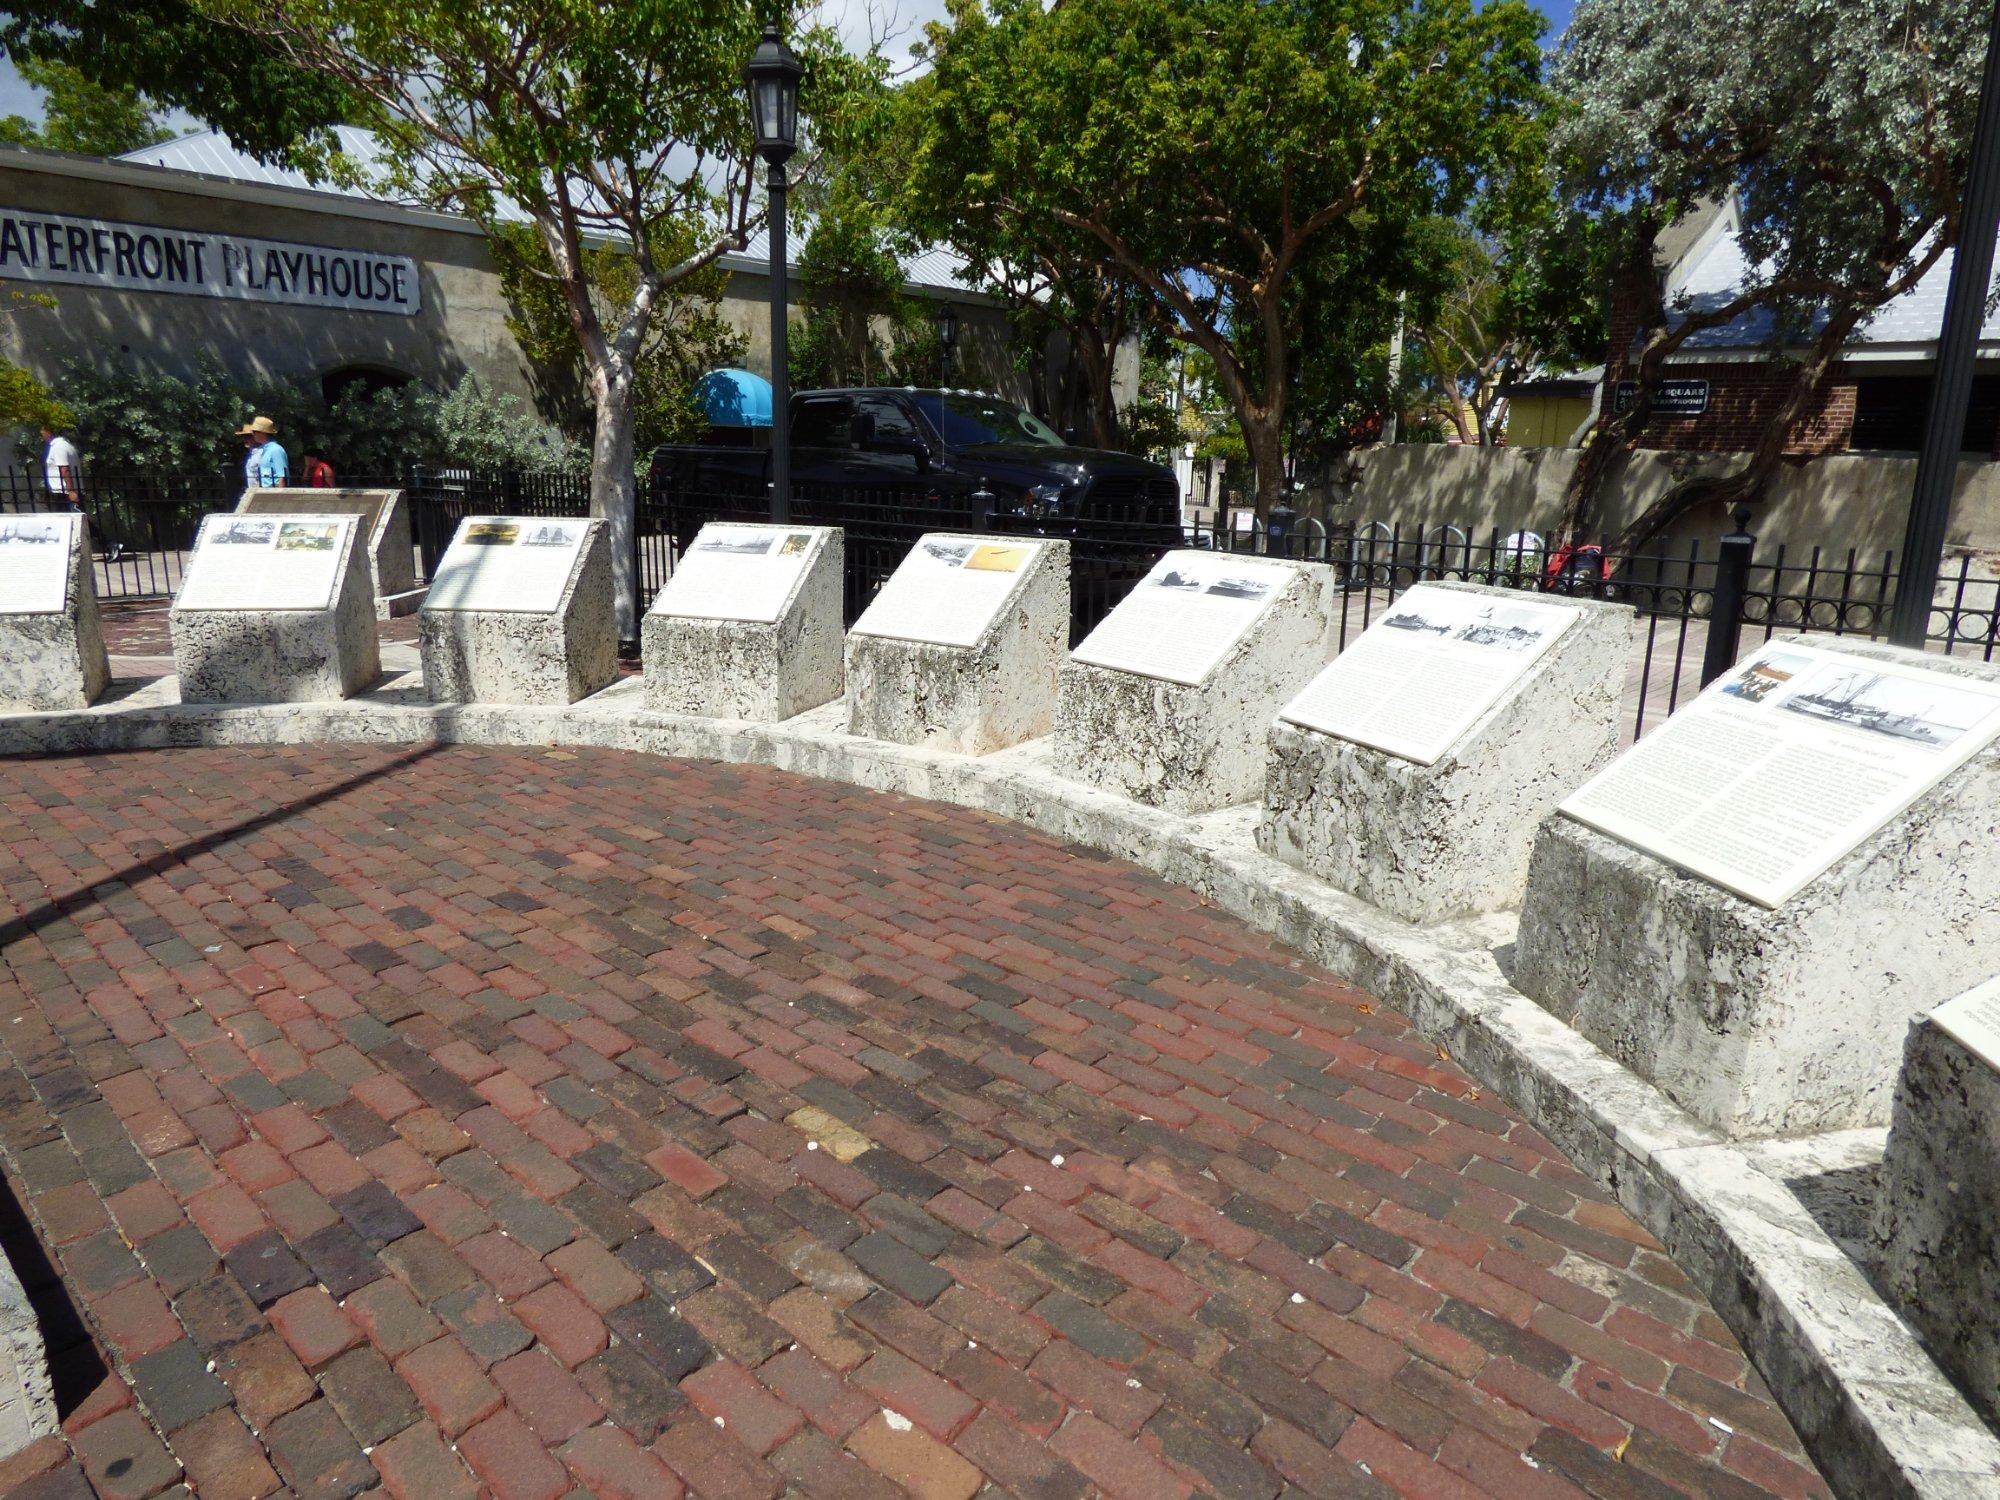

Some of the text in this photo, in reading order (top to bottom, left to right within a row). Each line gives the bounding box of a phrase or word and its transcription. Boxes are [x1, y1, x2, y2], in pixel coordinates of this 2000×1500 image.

[0, 218, 408, 304] ATERFRONT PLAYHOUSE
[1666, 388, 1705, 397] SQUARE
